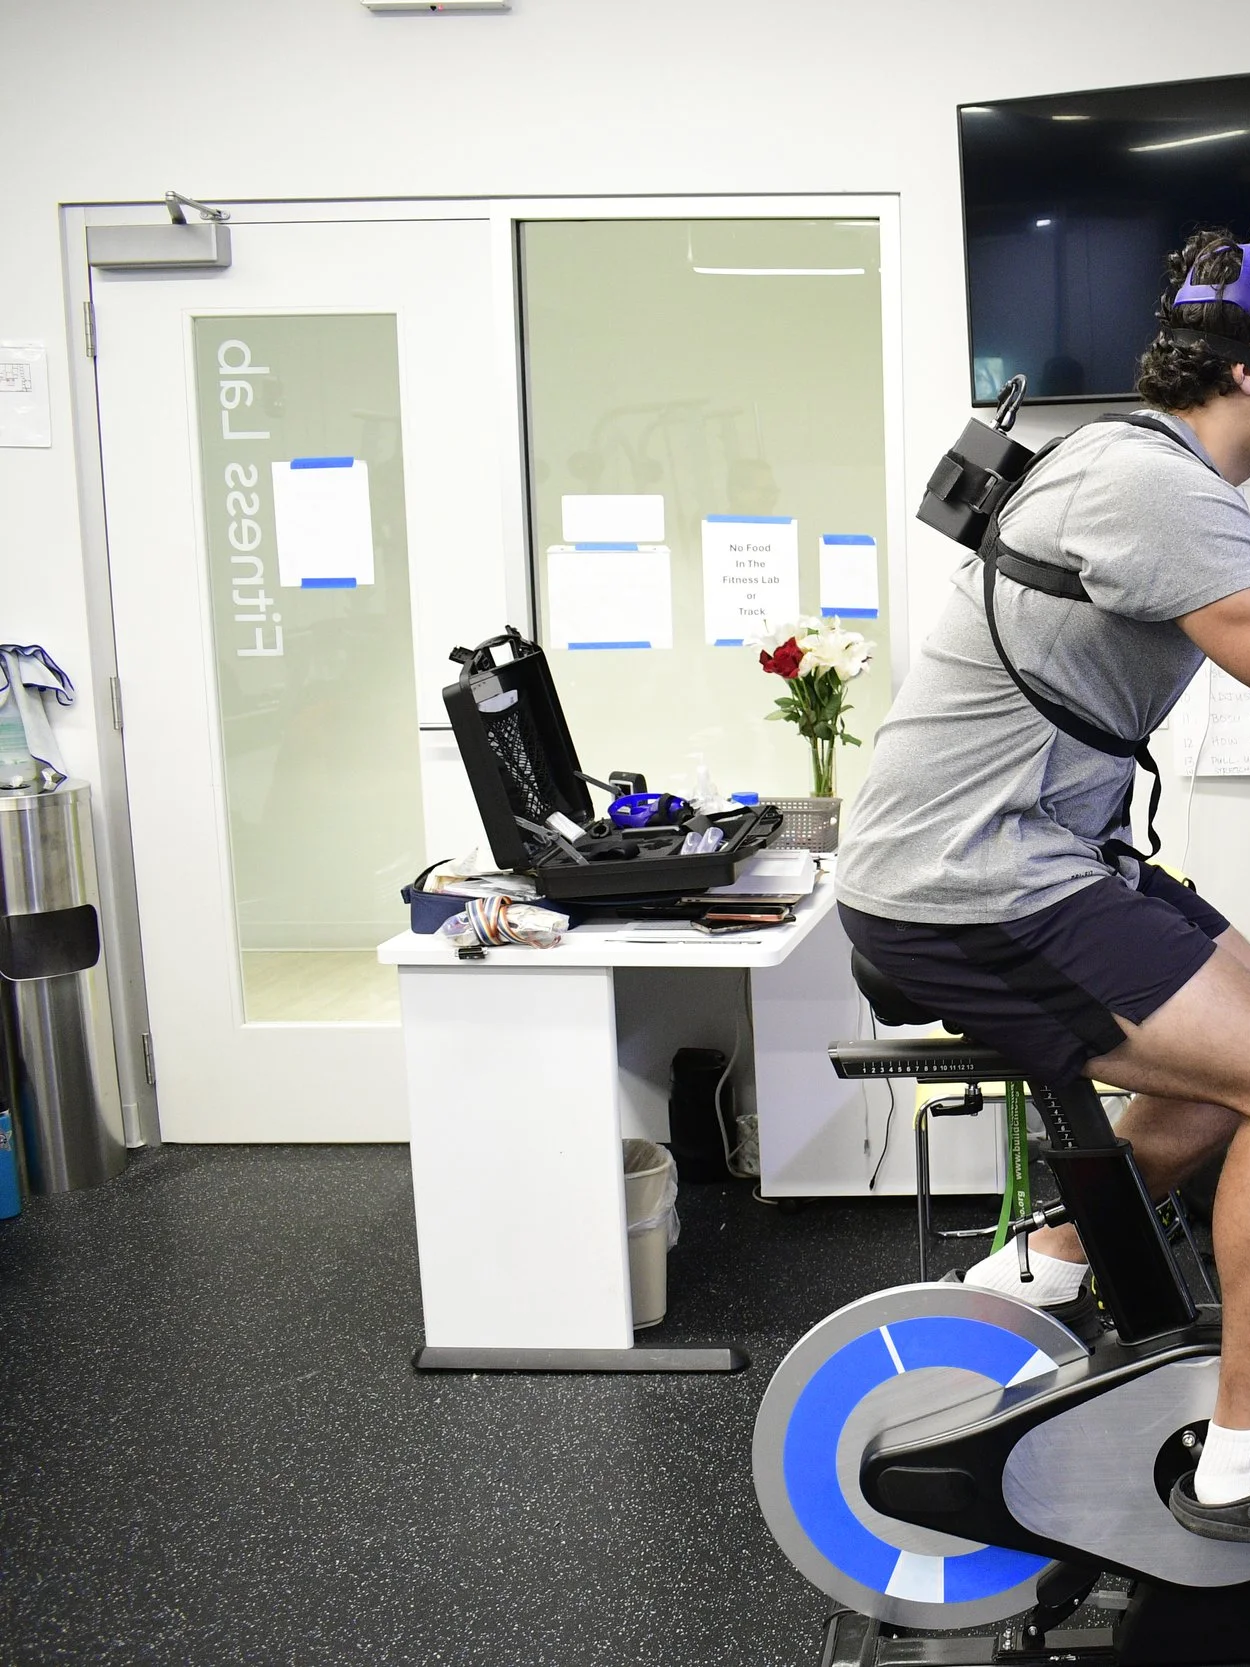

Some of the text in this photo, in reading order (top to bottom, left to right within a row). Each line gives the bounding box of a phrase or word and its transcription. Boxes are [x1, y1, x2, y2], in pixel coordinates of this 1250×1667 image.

[729, 543, 771, 552] No Food
[735, 559, 766, 568] In The
[722, 575, 780, 584] Fitness Lab
[739, 607, 766, 616] Track
[1212, 736, 1238, 745] HOW
[1016, 1190, 1026, 1217] o.org
